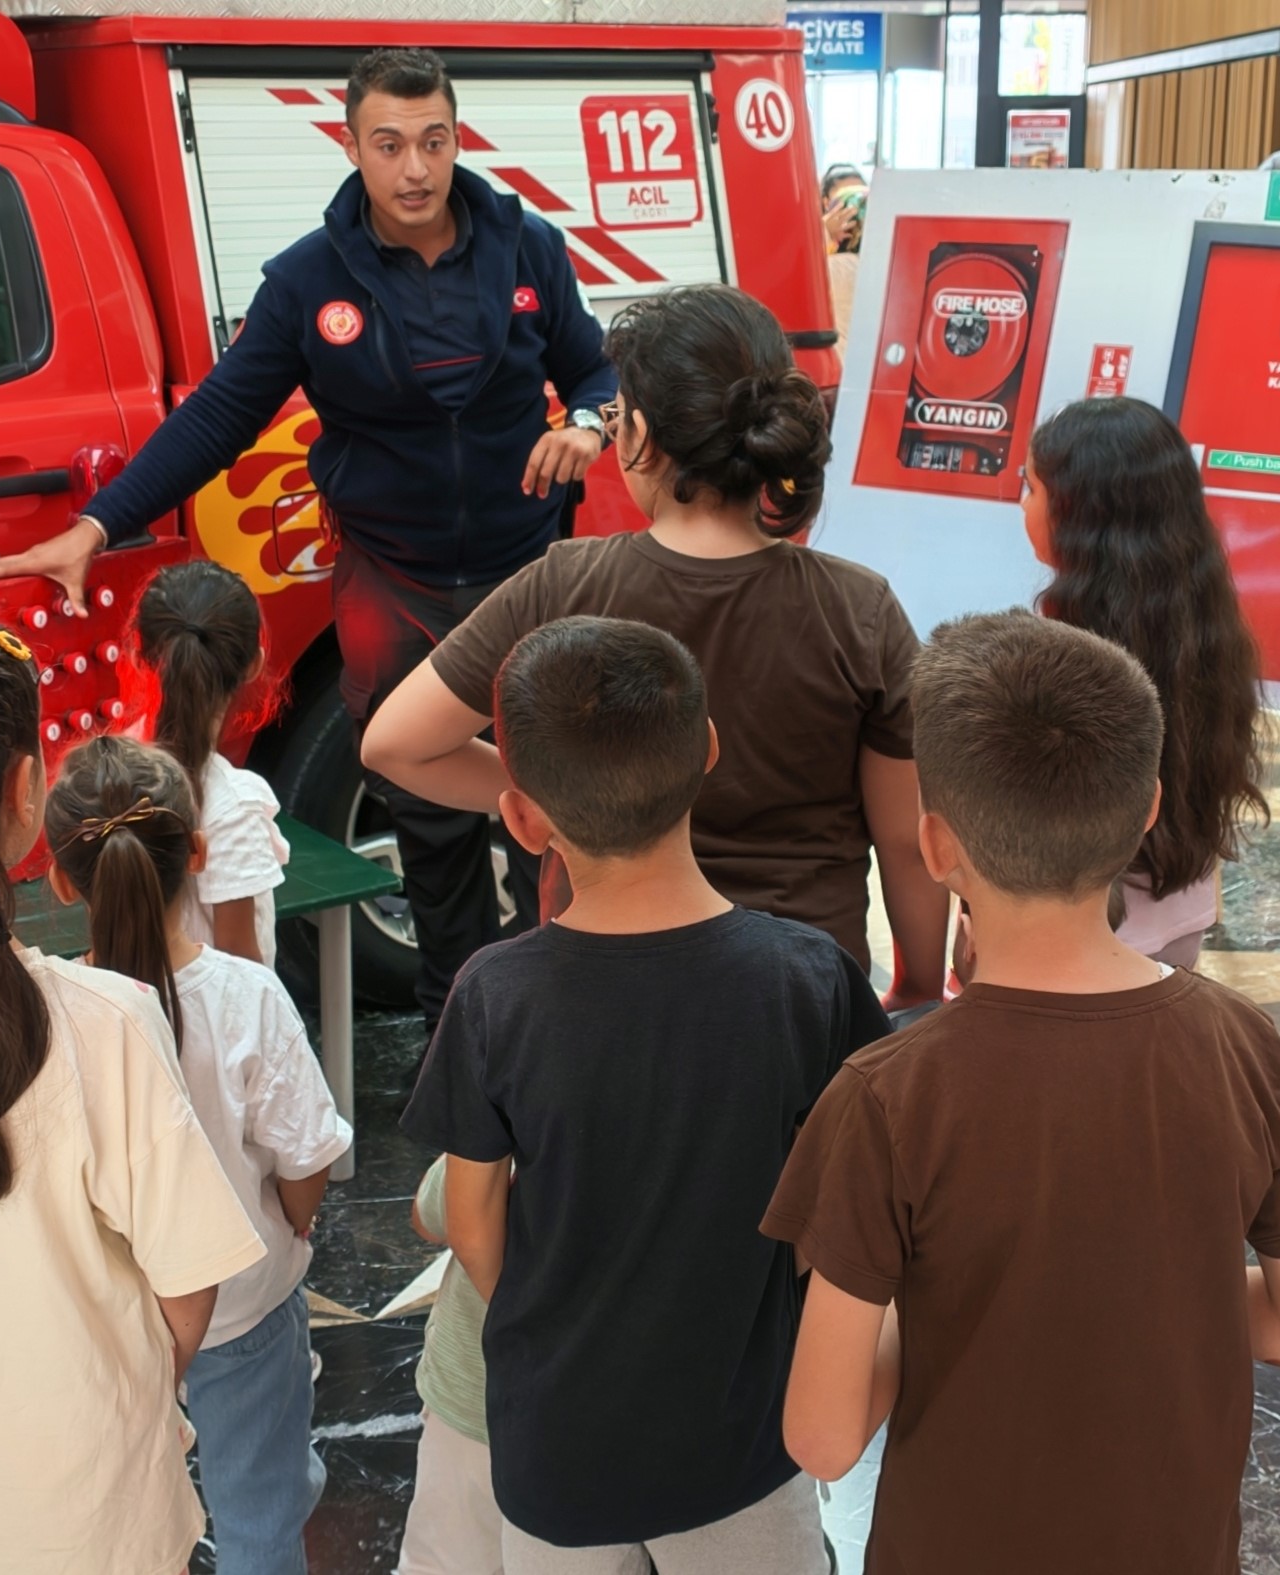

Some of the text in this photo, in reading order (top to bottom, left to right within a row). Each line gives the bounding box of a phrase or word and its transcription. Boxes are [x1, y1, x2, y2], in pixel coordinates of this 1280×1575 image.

[745, 91, 786, 138] 40
[598, 109, 682, 173] 112
[937, 295, 1022, 314] FIRE HOSE
[923, 405, 1002, 427] YANGIN
[1233, 454, 1263, 470] Push
